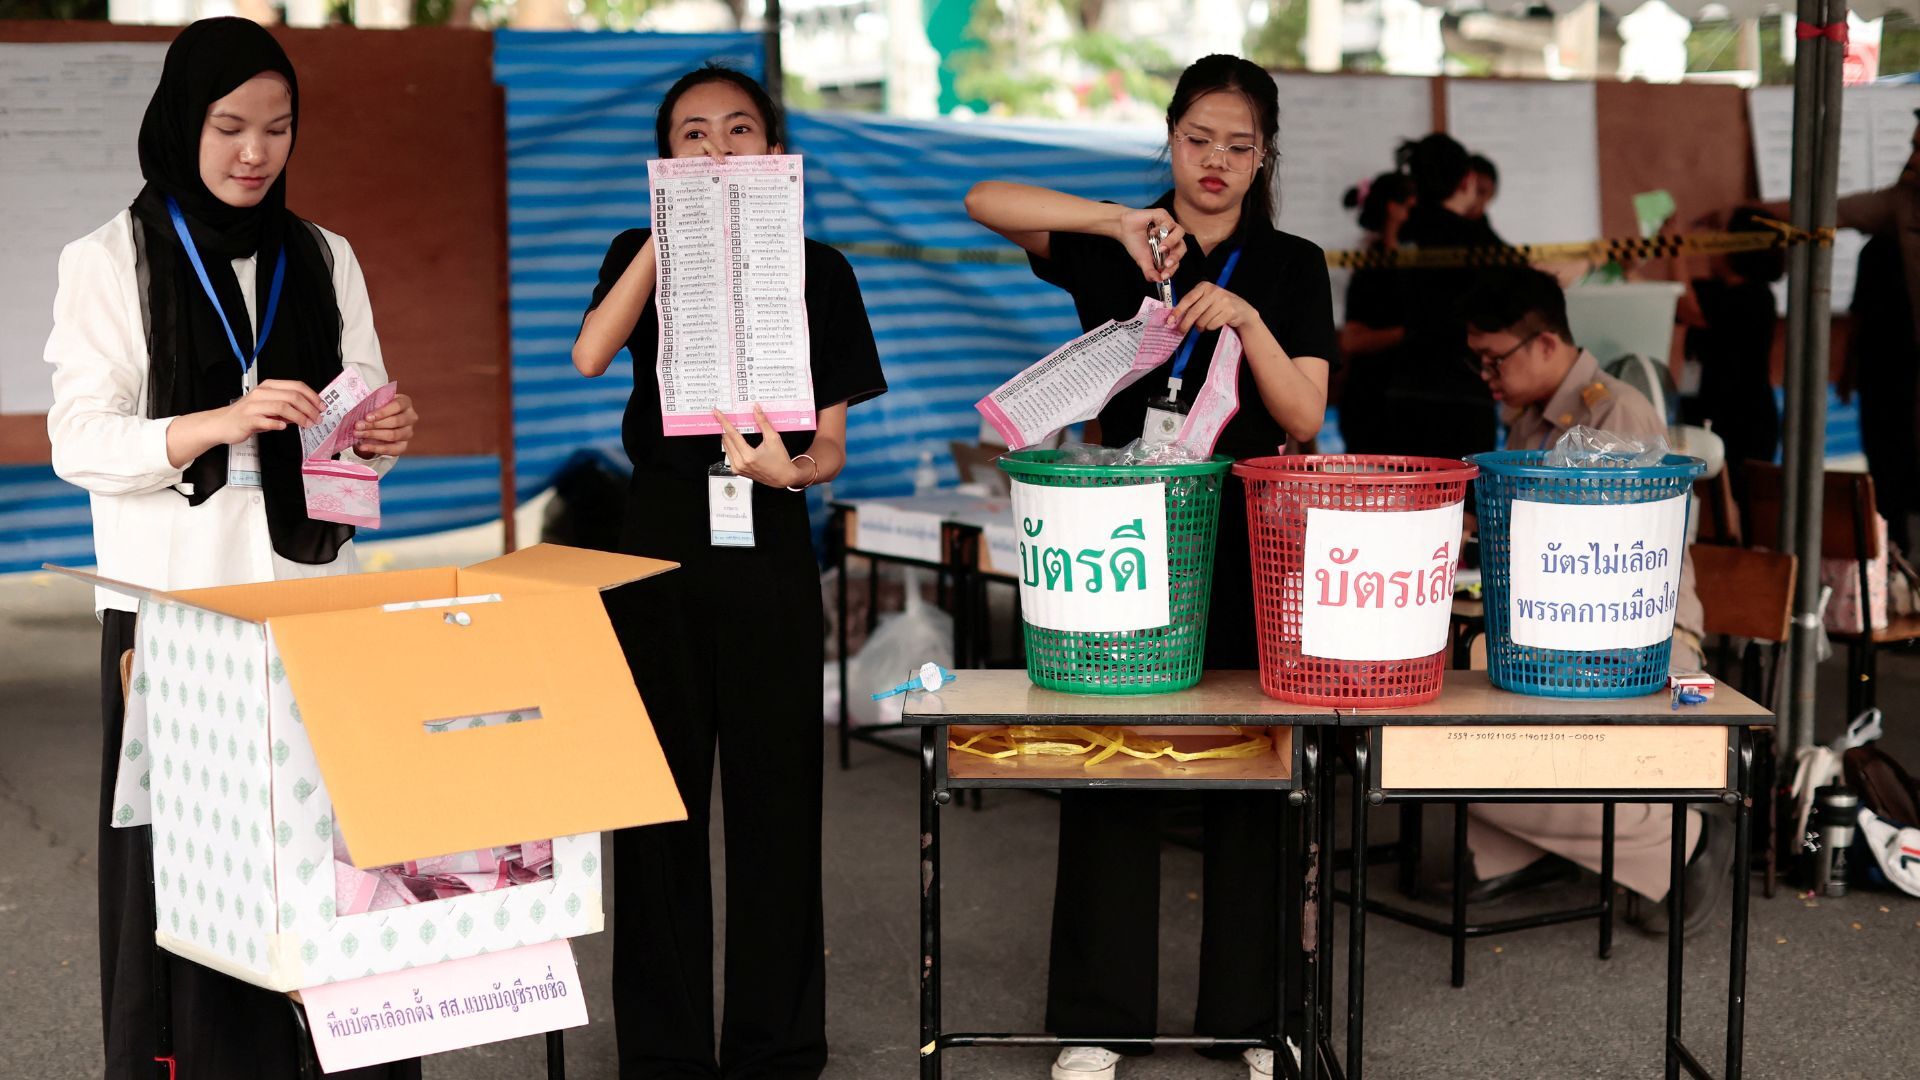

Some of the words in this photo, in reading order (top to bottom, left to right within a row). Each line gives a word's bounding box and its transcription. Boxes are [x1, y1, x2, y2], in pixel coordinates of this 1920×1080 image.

[1020, 517, 1147, 594] บัตรดี
[1541, 540, 1668, 575] บัตรไม่เลือก
[1517, 581, 1676, 623] พรรคการเมืองใด
[326, 988, 434, 1038] หีบบัตรเลือกตั้ง
[439, 965, 567, 1018] สส.แบบบัญชีรายชื่อ
